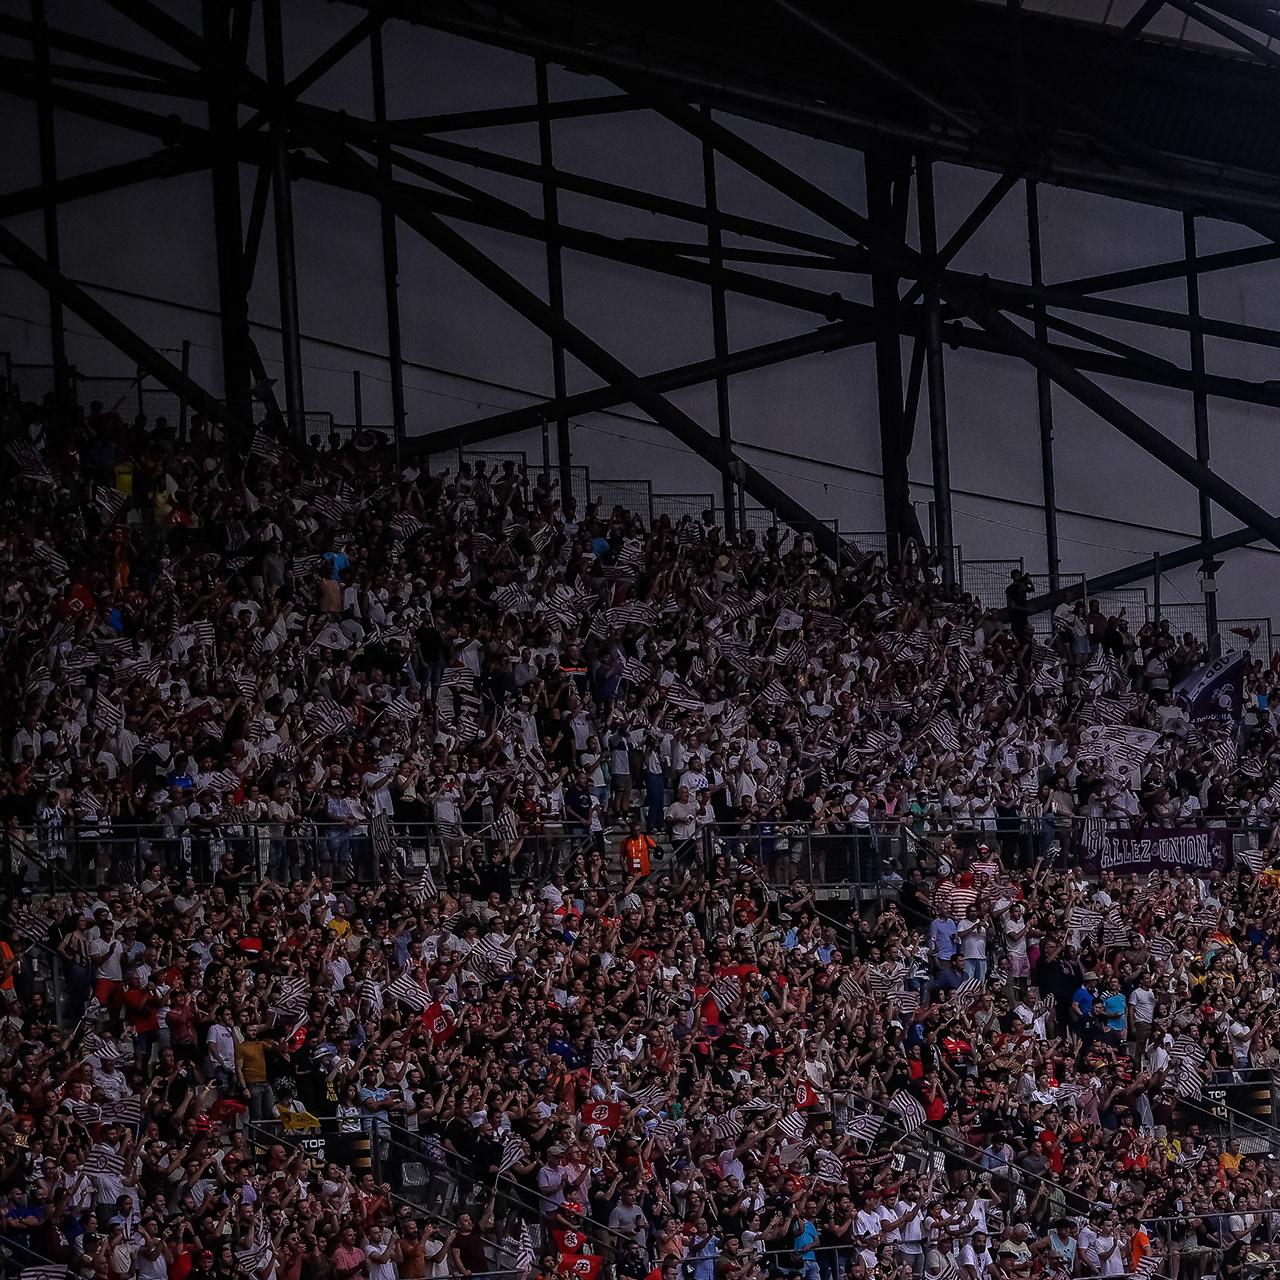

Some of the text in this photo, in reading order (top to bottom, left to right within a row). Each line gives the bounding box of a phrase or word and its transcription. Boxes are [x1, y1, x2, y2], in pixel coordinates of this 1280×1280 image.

[1101, 833, 1209, 868] ALLEZ UNION
[1208, 1090, 1226, 1099] TOP
[1211, 1106, 1228, 1118] 14
[302, 1138, 326, 1148] TOP
